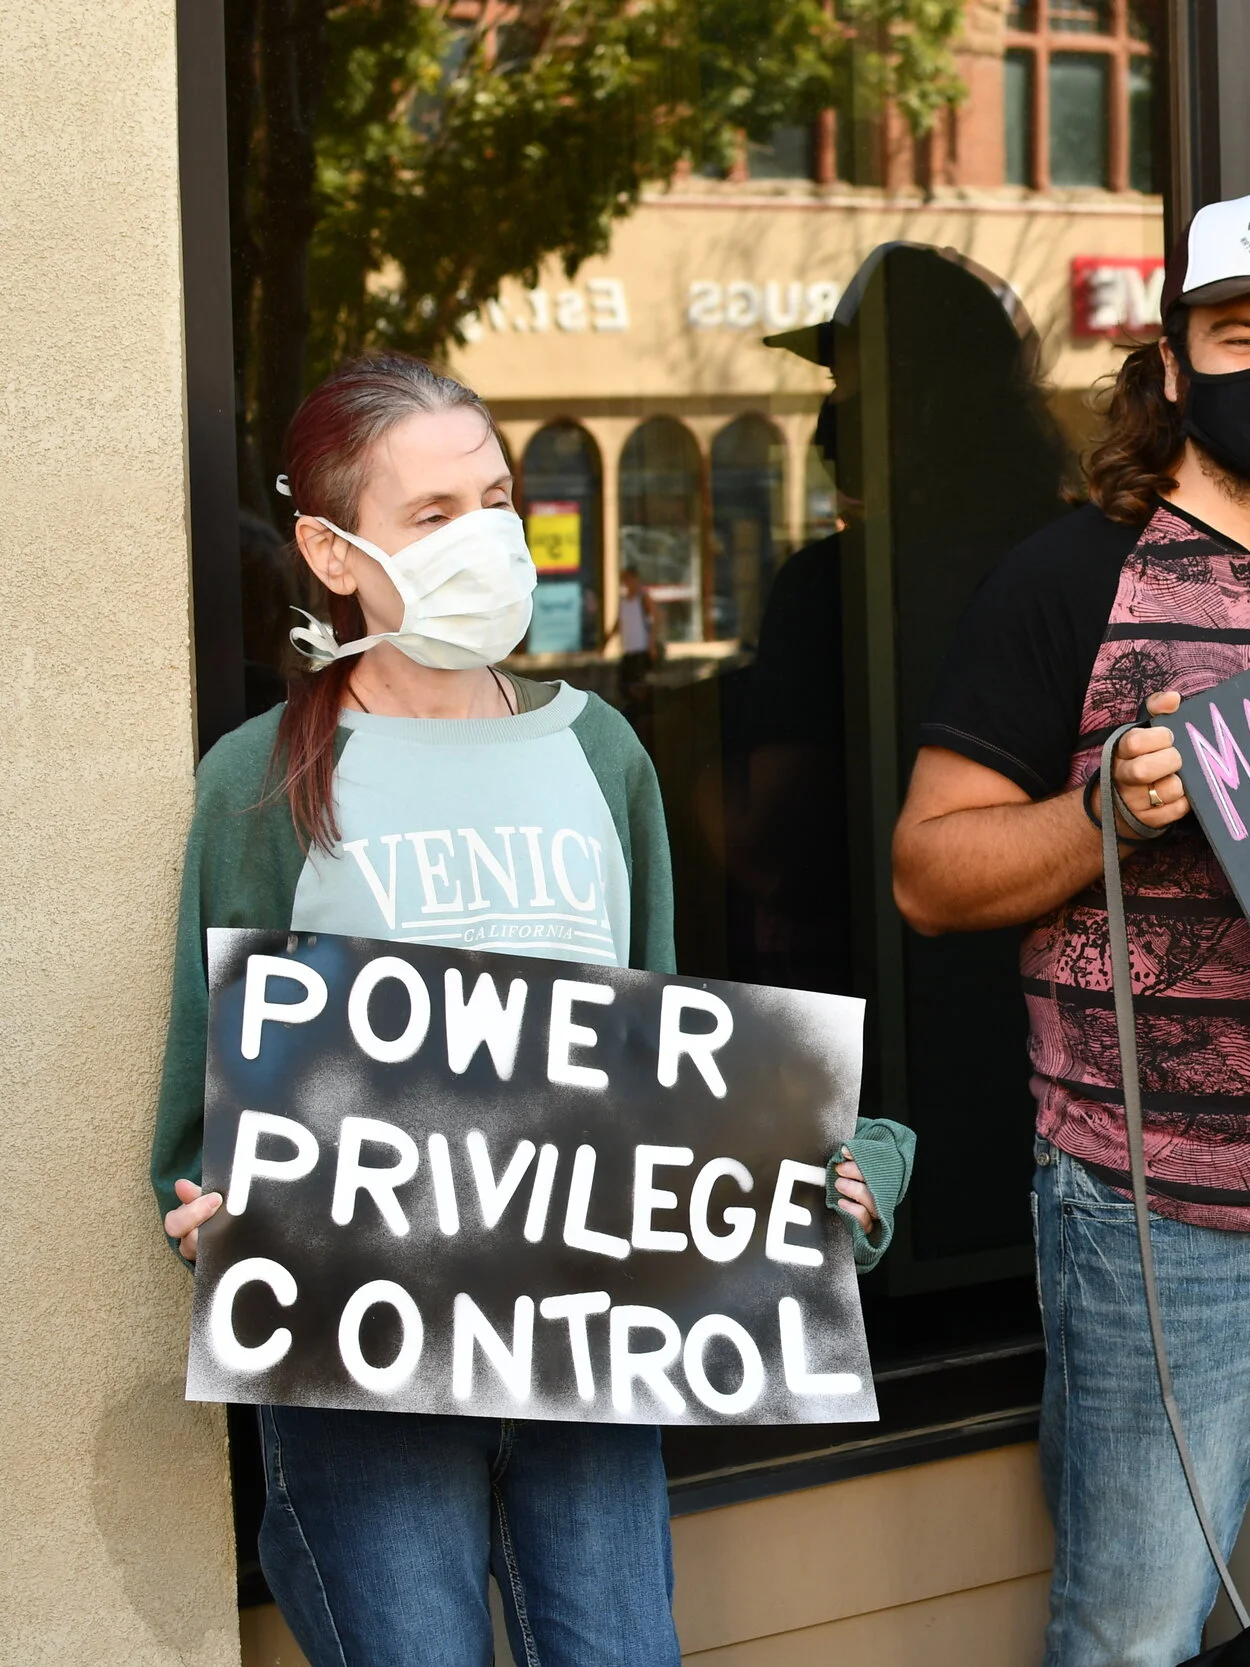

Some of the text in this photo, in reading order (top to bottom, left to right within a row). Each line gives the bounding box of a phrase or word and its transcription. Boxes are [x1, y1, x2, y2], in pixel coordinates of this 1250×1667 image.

[463, 924, 574, 943] CALIFORNIA
[240, 953, 735, 1100] POWER
[225, 1109, 827, 1267] PRIVILEGE
[208, 1256, 864, 1417] CONTROL
